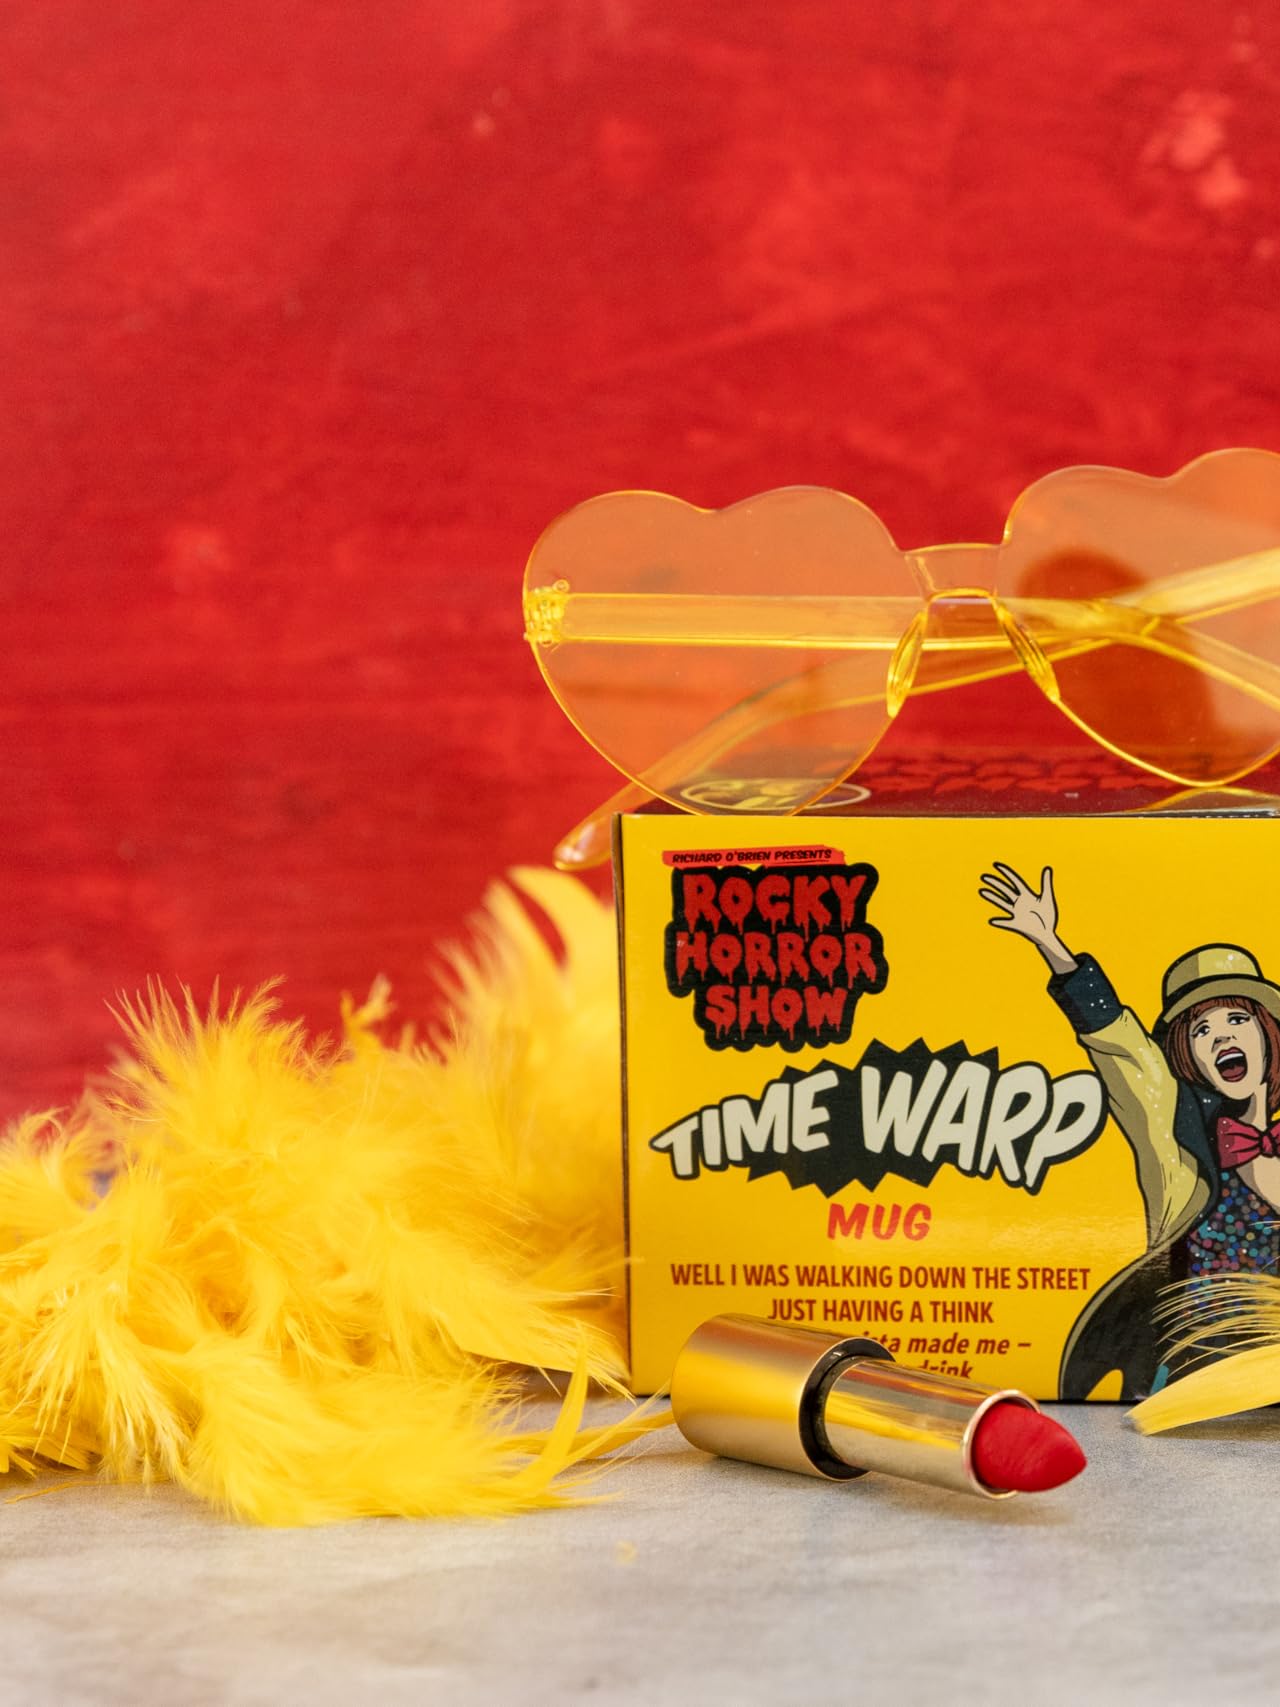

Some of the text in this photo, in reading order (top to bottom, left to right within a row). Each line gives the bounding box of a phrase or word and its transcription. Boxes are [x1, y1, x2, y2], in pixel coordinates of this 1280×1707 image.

[672, 849, 832, 863] RICHARD O'BRIEN PRESENTS
[682, 874, 867, 942] ROCKY
[675, 931, 877, 989] HORROR
[705, 984, 848, 1040] SHOW
[650, 1059, 1102, 1189] TIME WARP
[827, 1203, 932, 1241] MUG
[671, 1263, 1090, 1291] WELL I WAS WALKING DOWN THE STREET
[768, 1299, 994, 1323] JUST HAVING A THINK
[907, 1332, 970, 1354] made
[976, 1339, 1010, 1354] me
